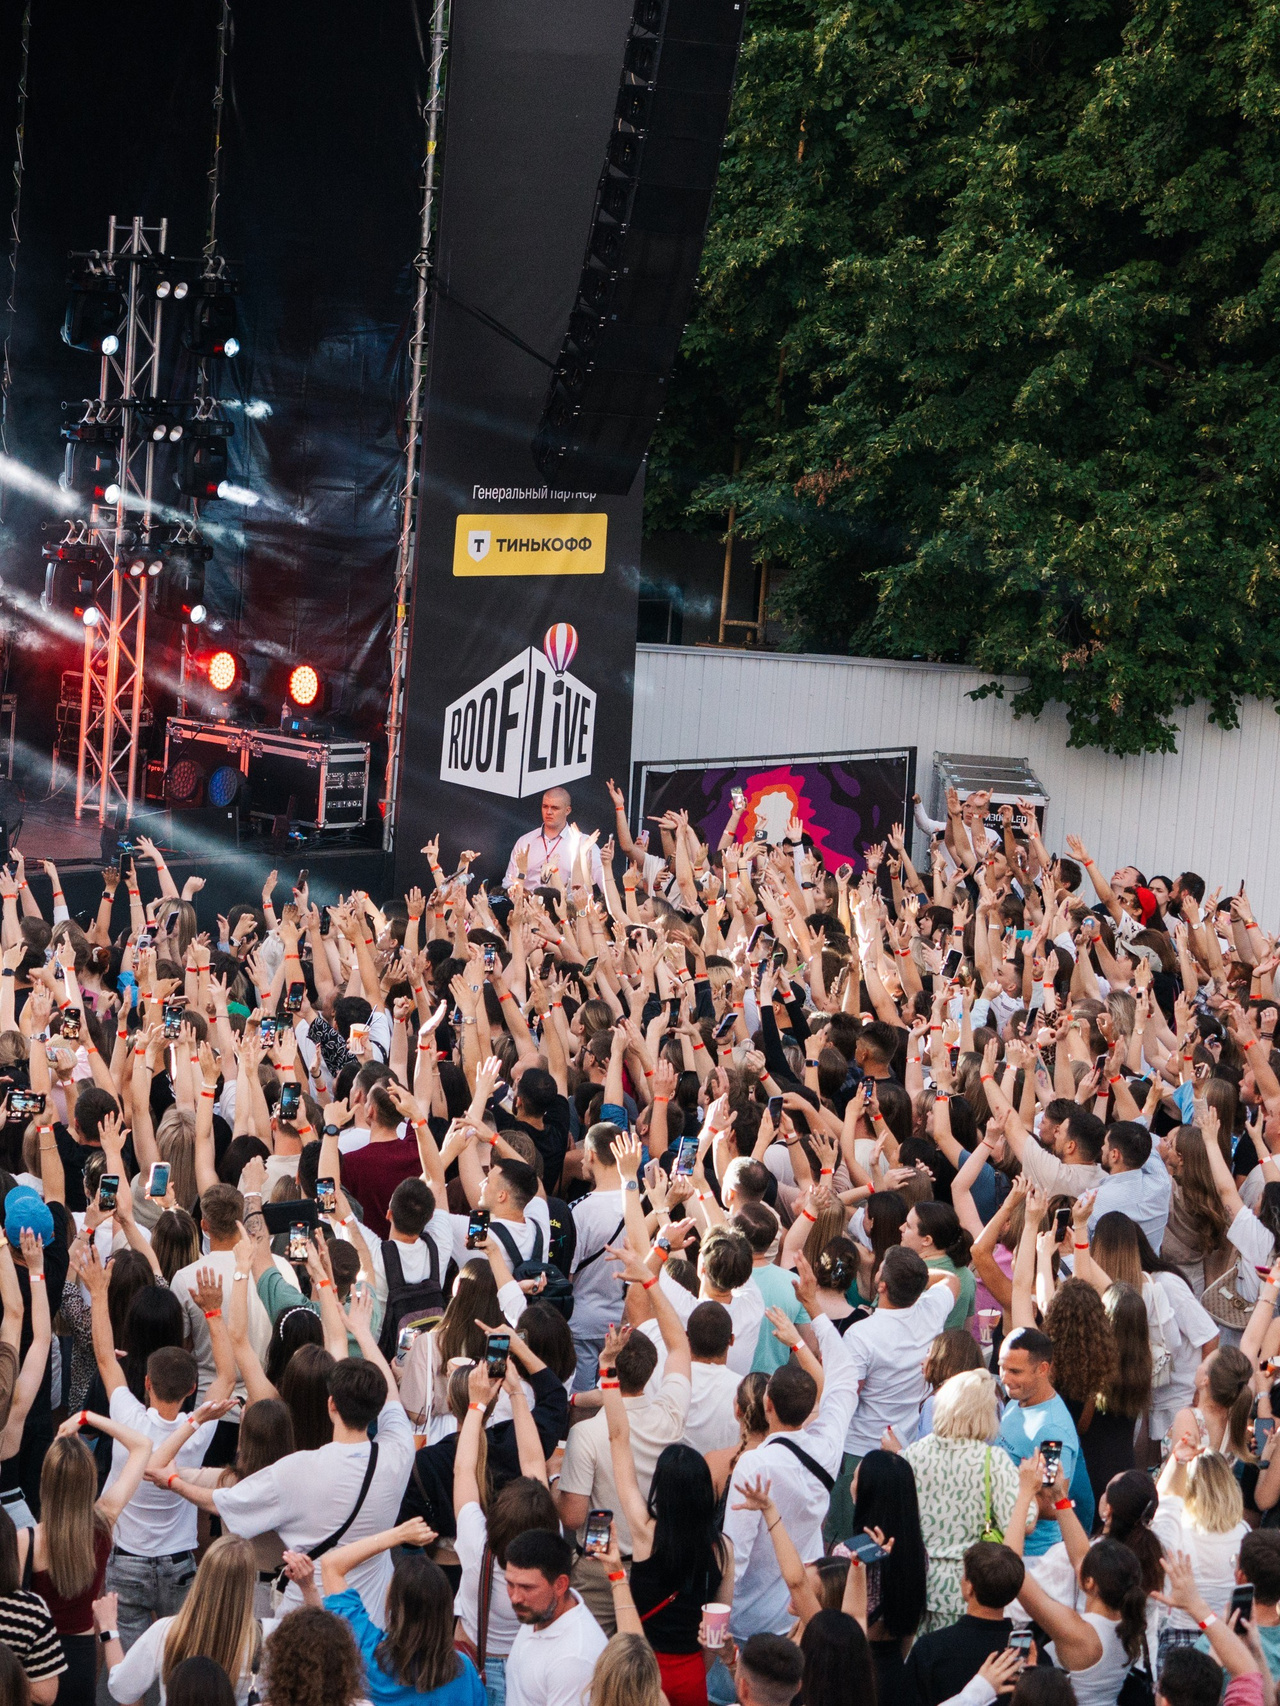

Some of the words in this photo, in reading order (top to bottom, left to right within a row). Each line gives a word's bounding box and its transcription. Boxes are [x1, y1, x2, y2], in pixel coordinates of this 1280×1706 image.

[472, 484, 549, 503] Генеральный
[496, 536, 593, 553] ТИНЬКОФФ
[447, 669, 525, 774] ROOF
